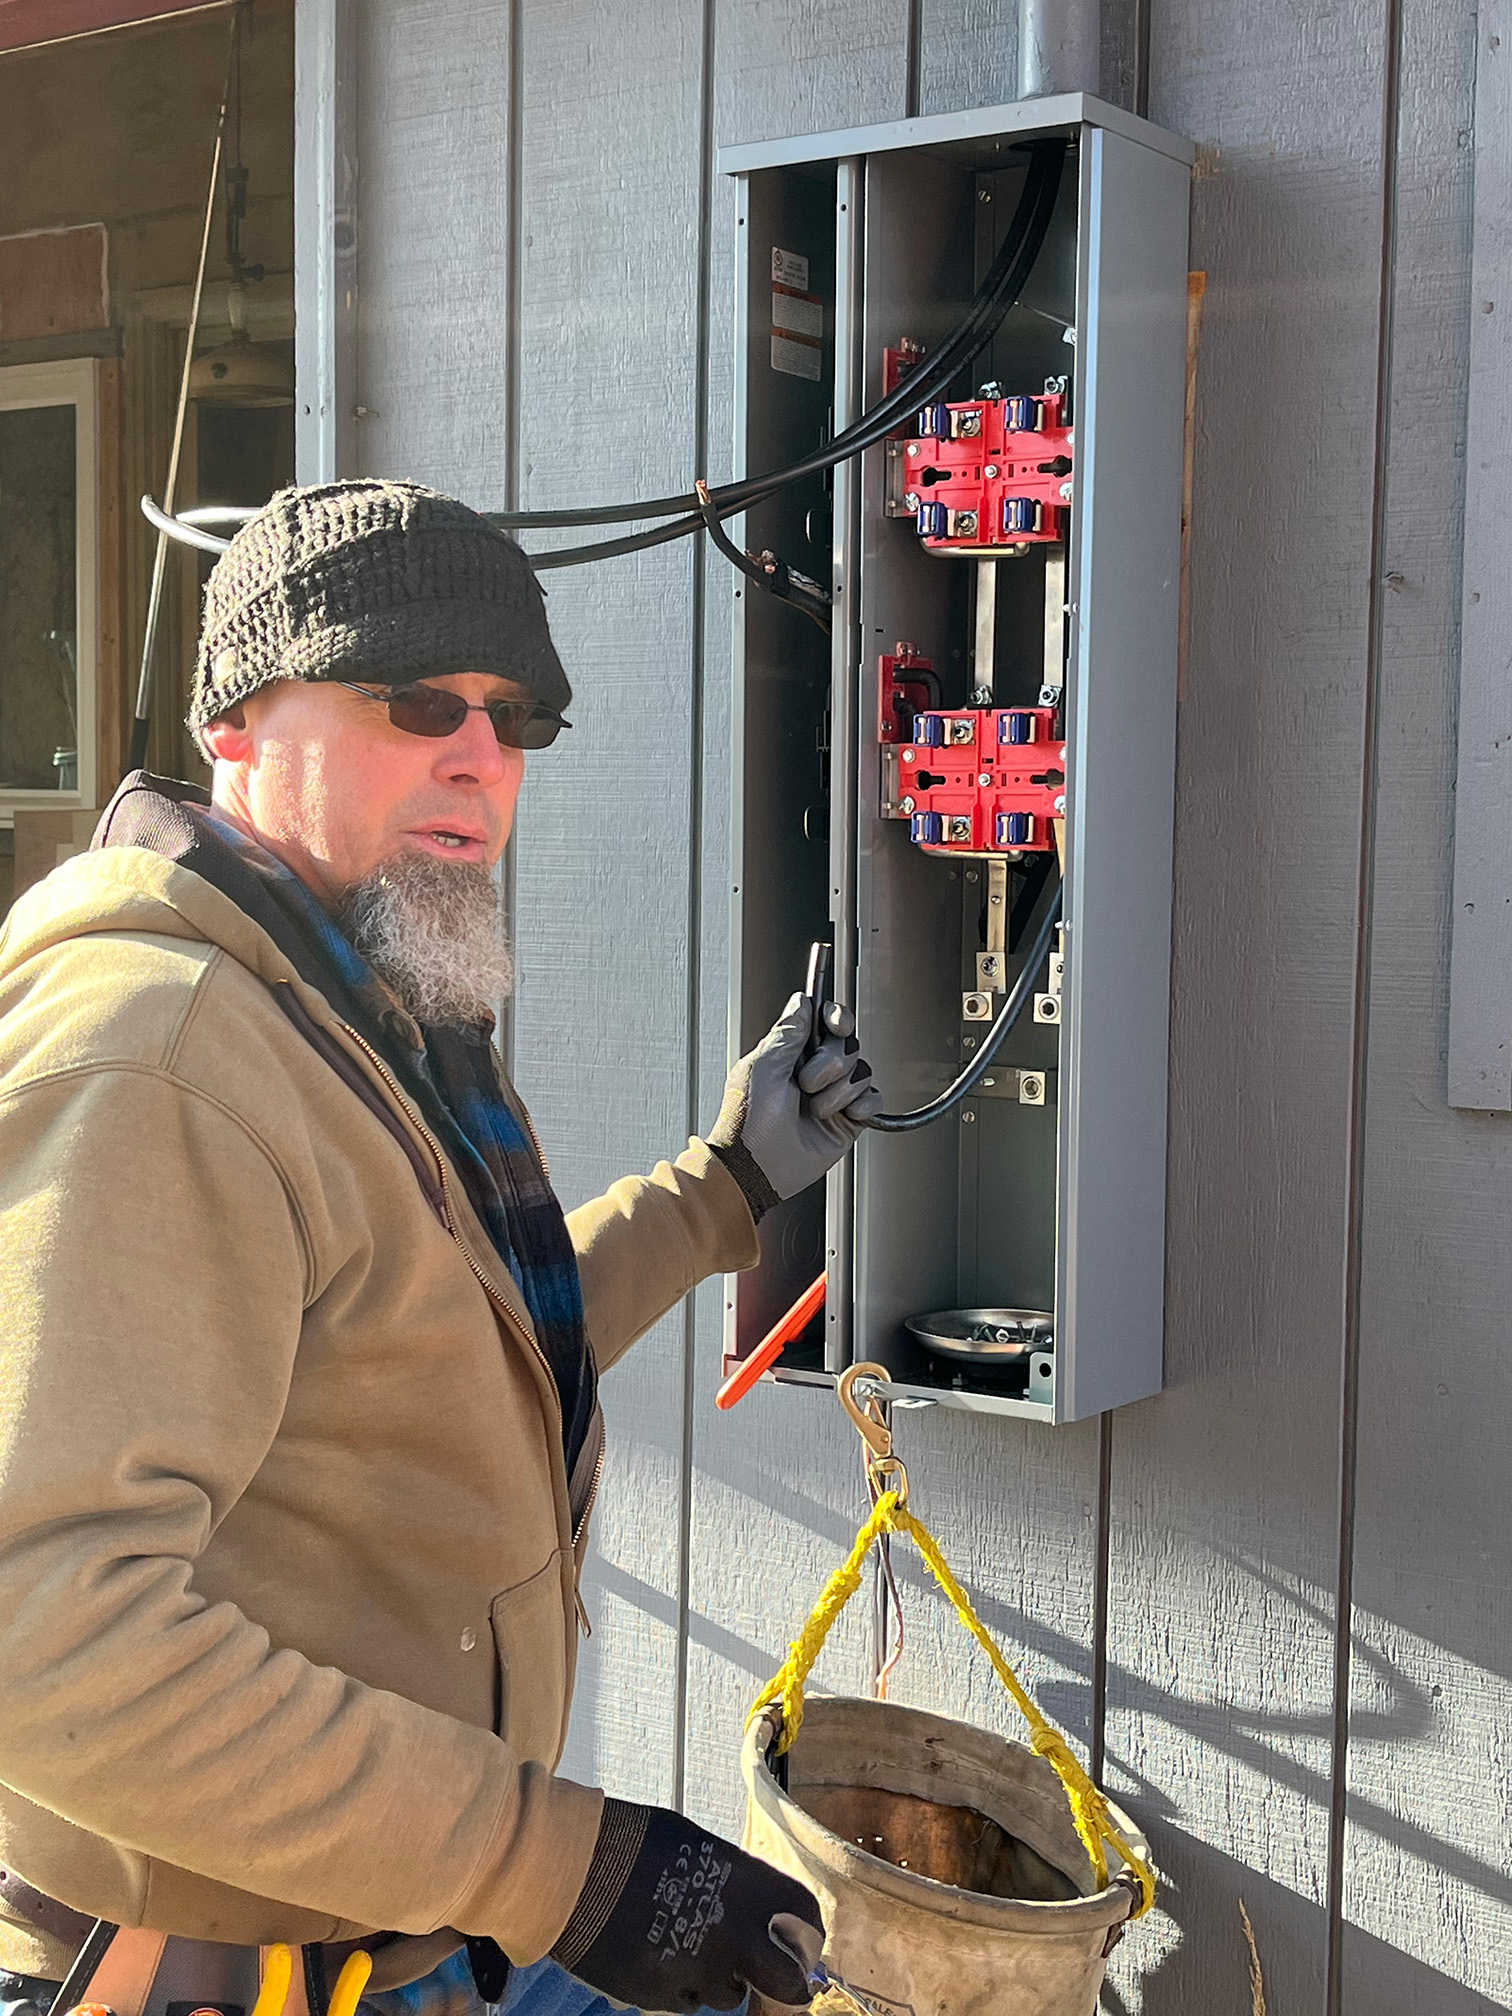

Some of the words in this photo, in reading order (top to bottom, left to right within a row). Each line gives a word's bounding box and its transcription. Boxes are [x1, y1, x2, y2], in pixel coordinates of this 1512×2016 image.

[676, 1844, 691, 1871] CE
[692, 1841, 713, 1888] 370
[682, 1860, 720, 1949] ATLAS
[660, 1916, 688, 1961] 8/L
